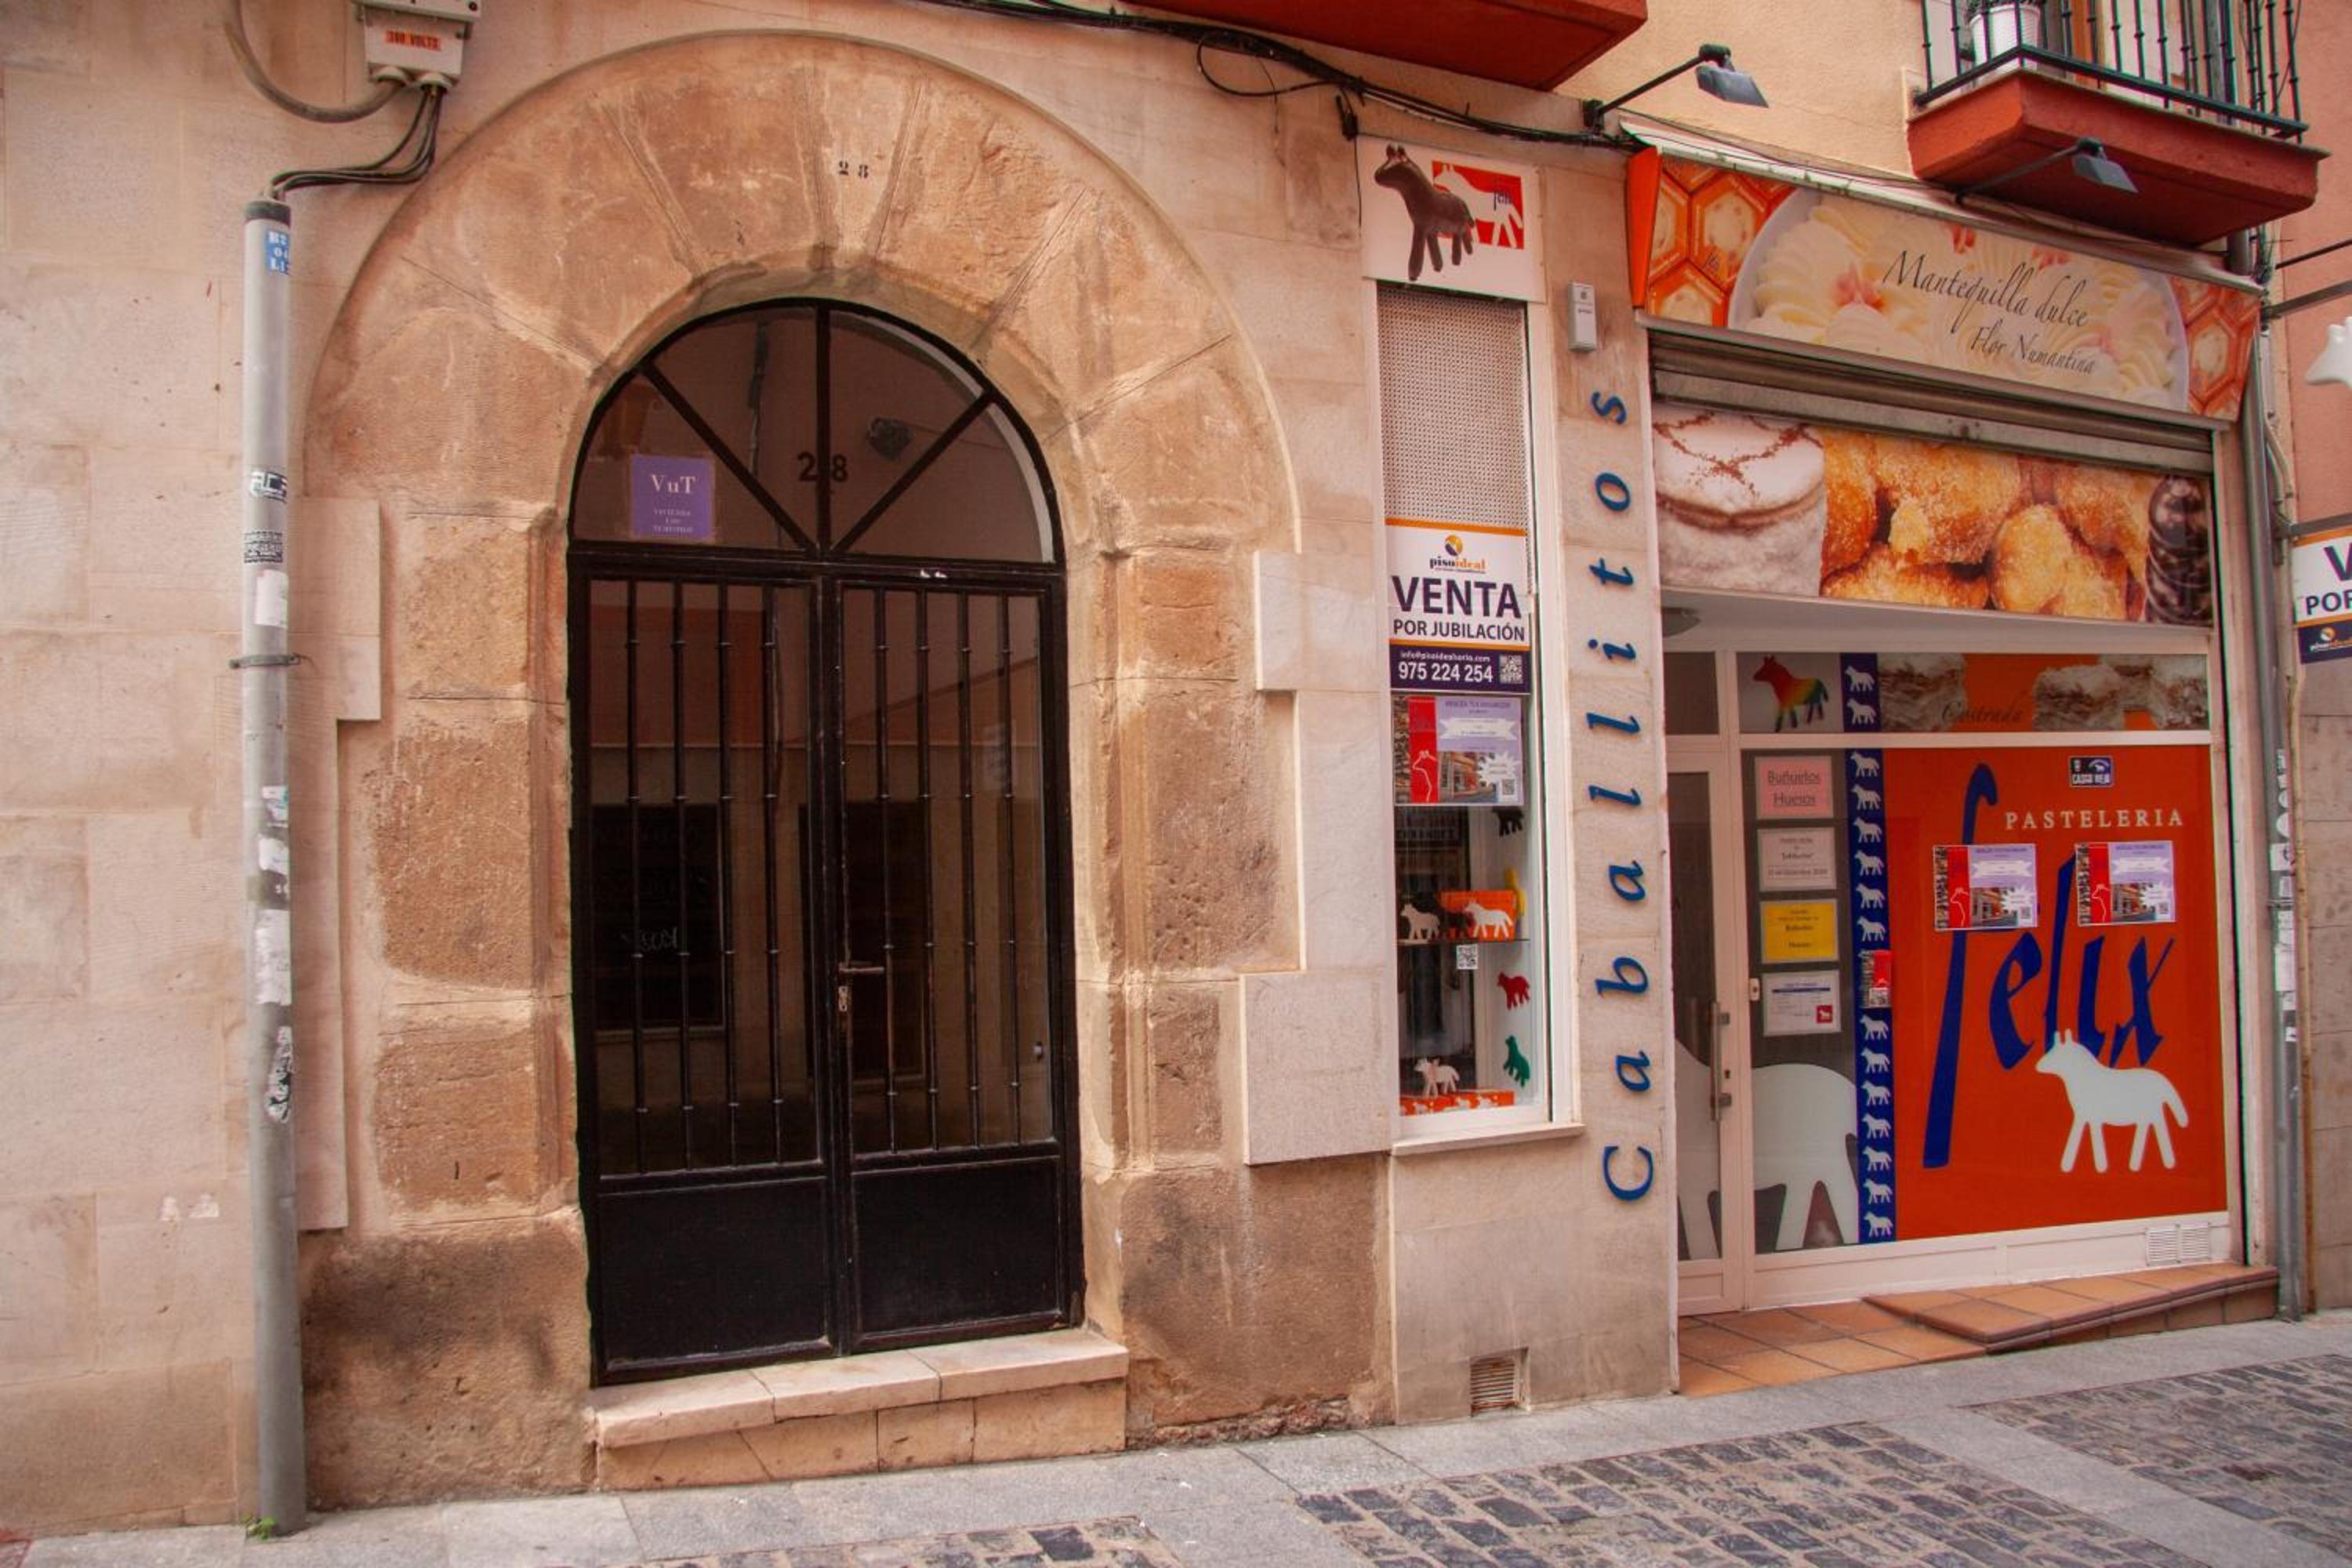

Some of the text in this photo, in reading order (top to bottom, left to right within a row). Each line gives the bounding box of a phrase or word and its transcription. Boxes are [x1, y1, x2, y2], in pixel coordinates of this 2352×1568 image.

[1882, 250, 2088, 334] Mantequilla dulce
[1970, 318, 2095, 375] Flor Numantina
[797, 451, 848, 483] 28
[650, 474, 697, 495] VuT
[1429, 555, 1486, 571] pisoideal
[1391, 575, 1523, 619] VENTA
[1393, 619, 1525, 642] POR JUBILACIÓN
[1398, 662, 1494, 684] 975 224 254
[1585, 390, 1654, 1203] Caballitos
[2004, 808, 2183, 830] PASTELERIA
